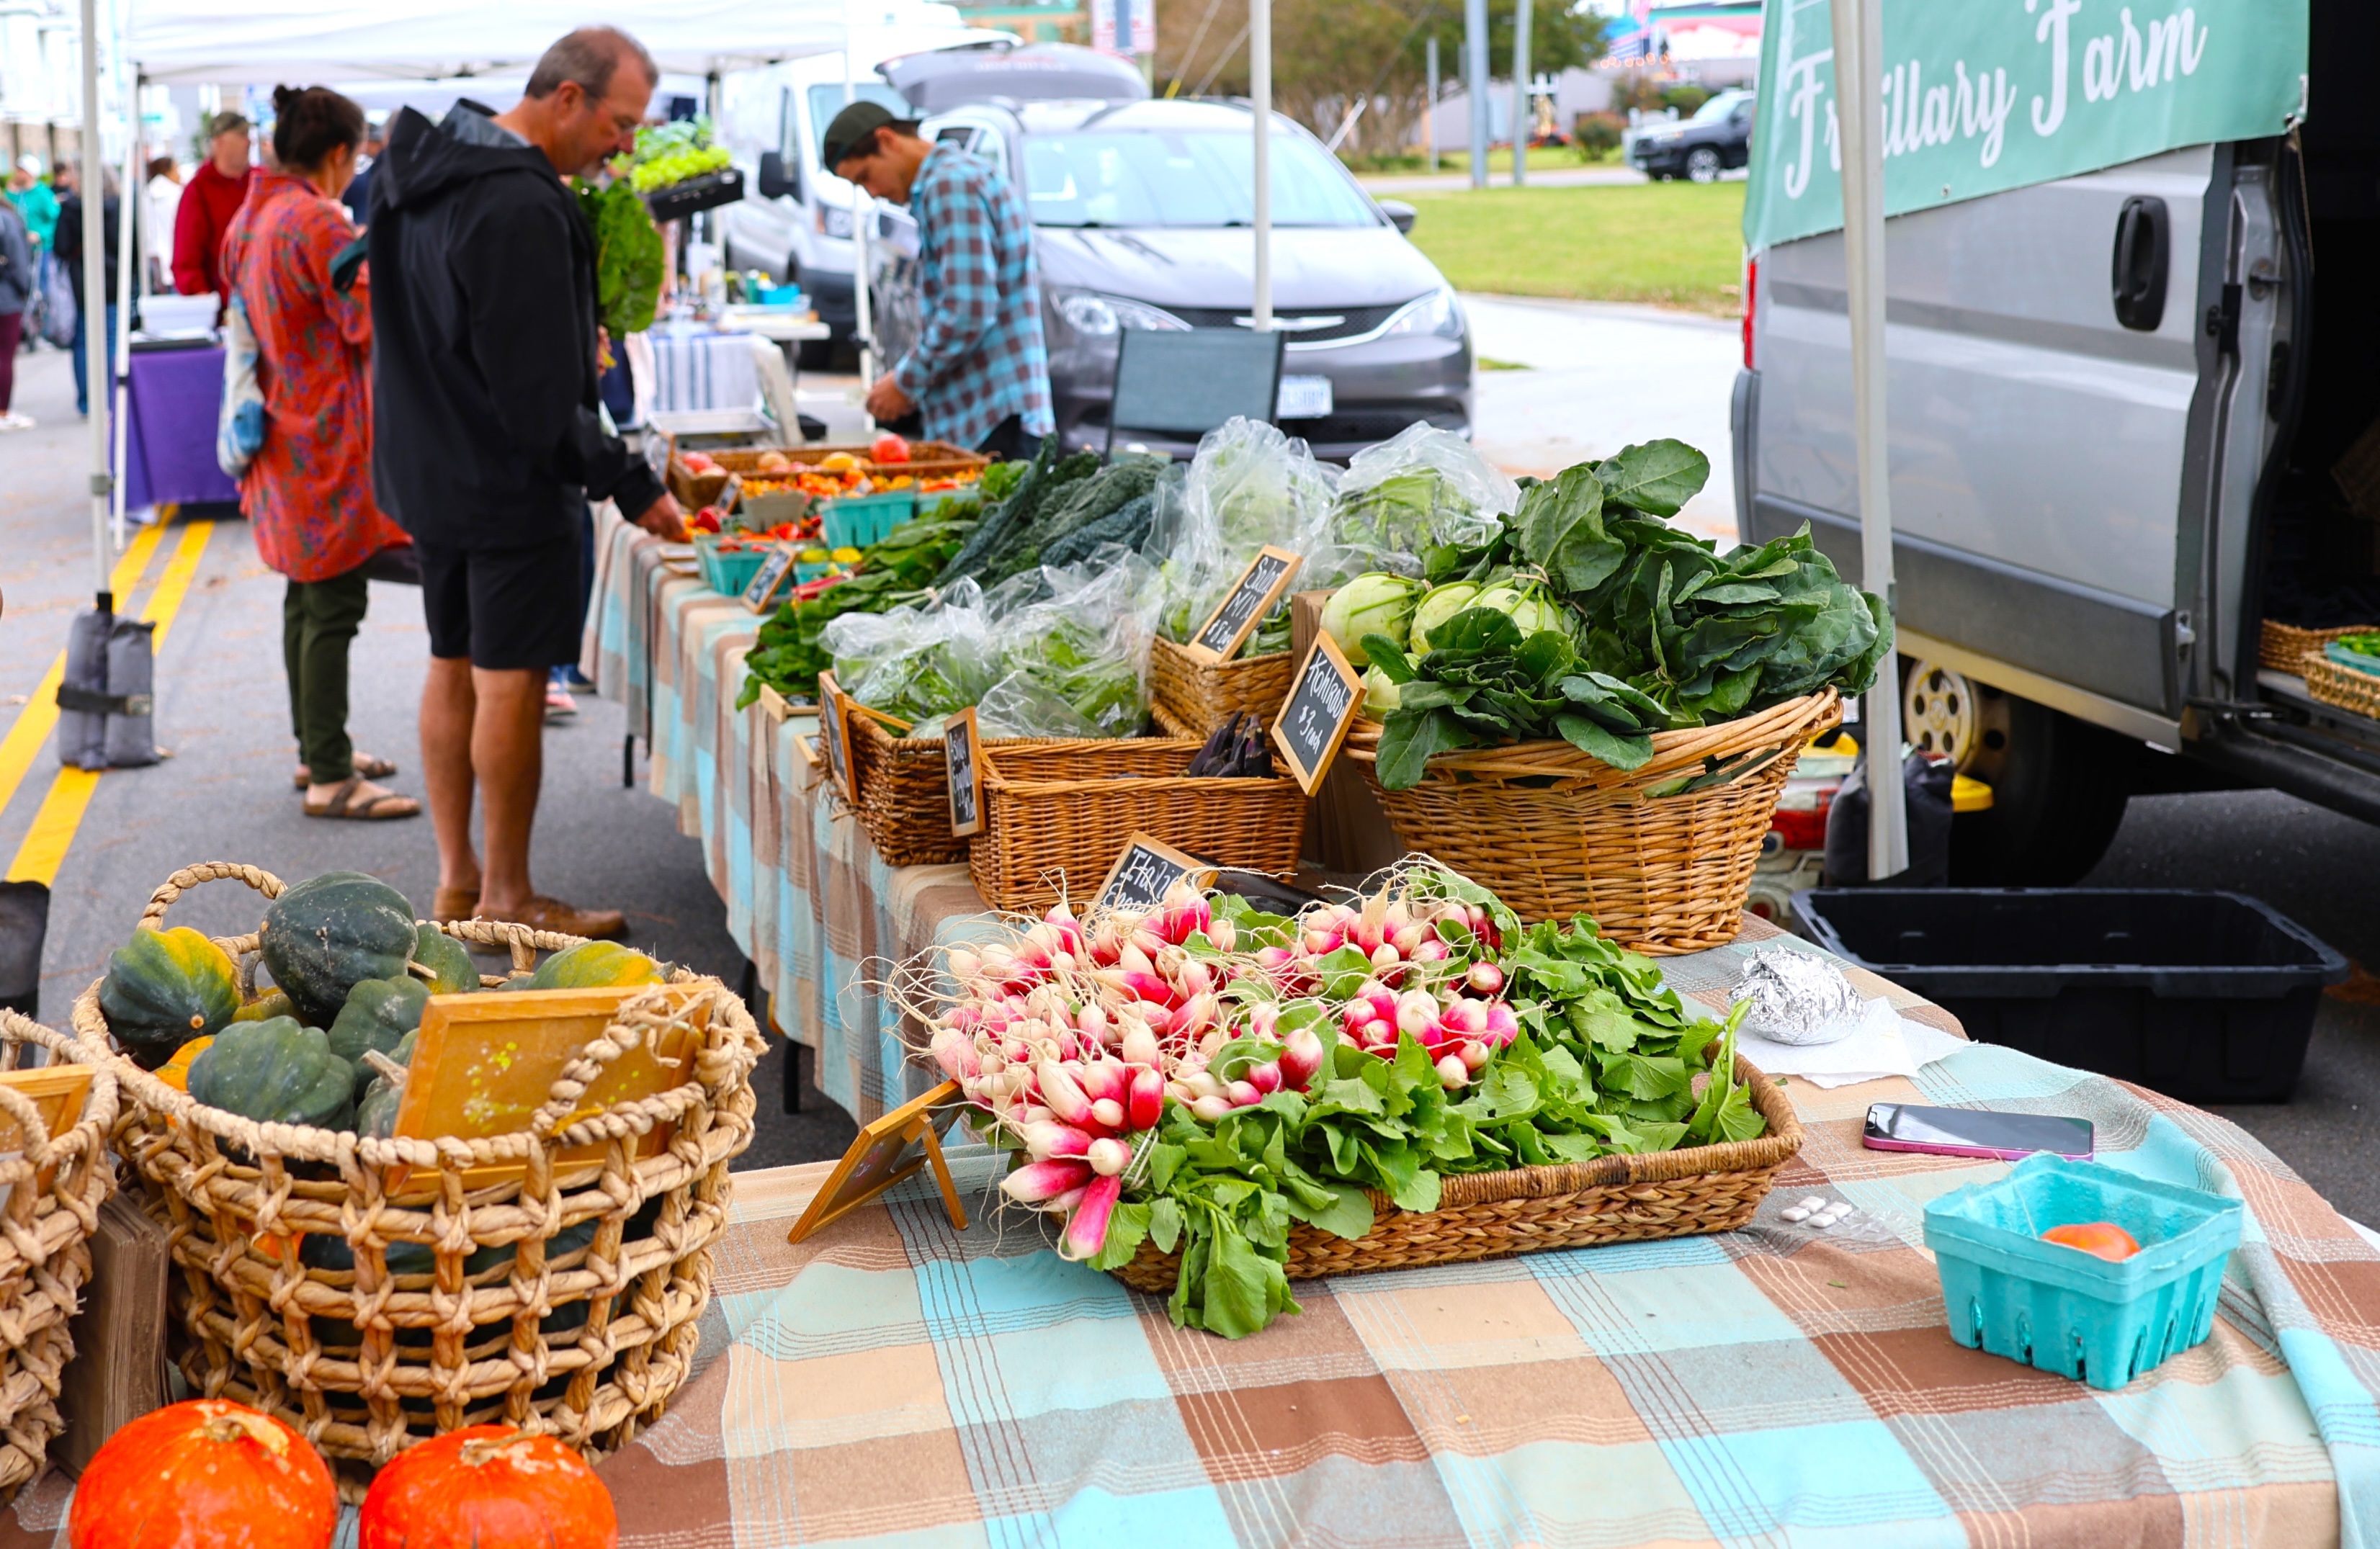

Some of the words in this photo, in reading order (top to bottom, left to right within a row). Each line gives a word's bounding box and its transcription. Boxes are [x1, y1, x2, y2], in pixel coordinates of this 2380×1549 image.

[1784, 48, 2017, 199] Frillary
[2026, 0, 2209, 137] Farm
[1298, 704, 1317, 736] $3
[1305, 729, 1324, 755] each
[1119, 848, 1181, 900] Itali
